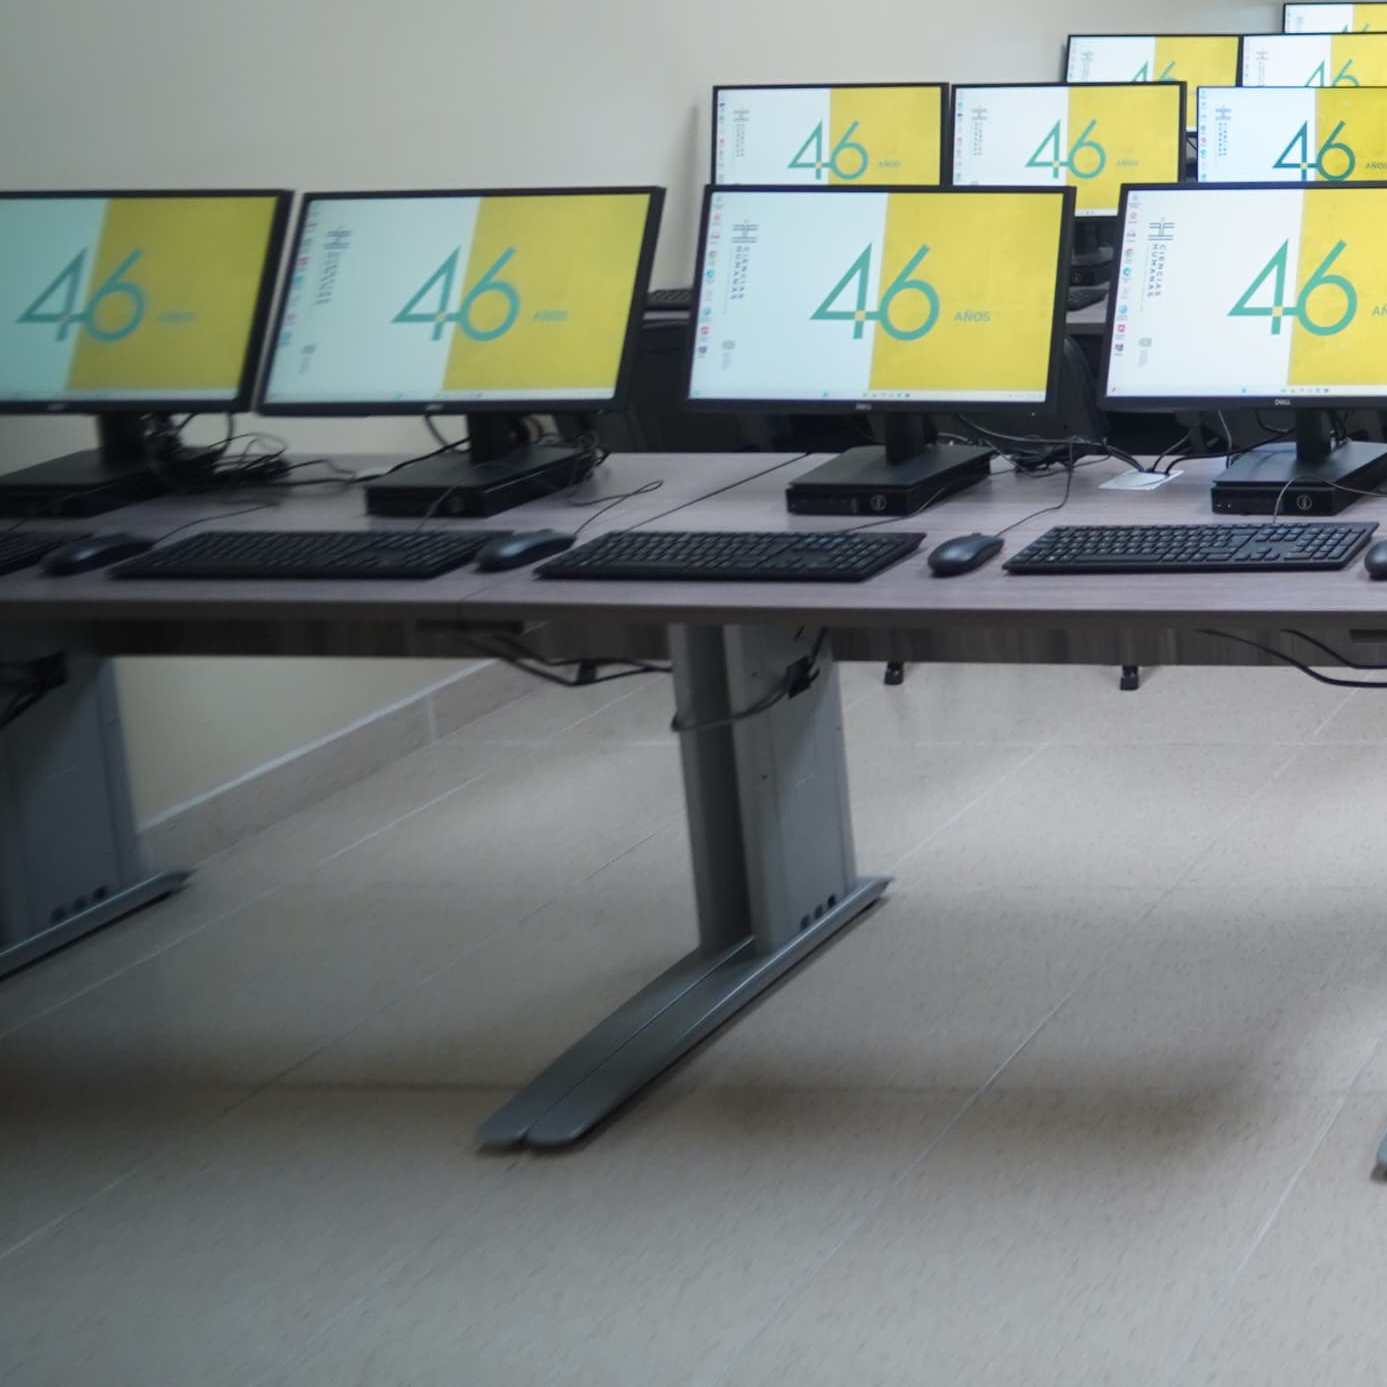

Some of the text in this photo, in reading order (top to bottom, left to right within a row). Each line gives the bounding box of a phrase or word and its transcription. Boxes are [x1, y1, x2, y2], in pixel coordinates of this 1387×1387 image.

[787, 119, 869, 181] 46
[1025, 119, 1107, 180] 46
[1272, 120, 1356, 181] 46
[14, 245, 145, 343] 46
[390, 245, 521, 343] 46
[809, 242, 941, 341] 46
[1146, 243, 1159, 298] HUMANAS
[1154, 243, 1166, 297] CIENCIAS
[1227, 238, 1358, 336] 46
[953, 308, 991, 322] AÑOS
